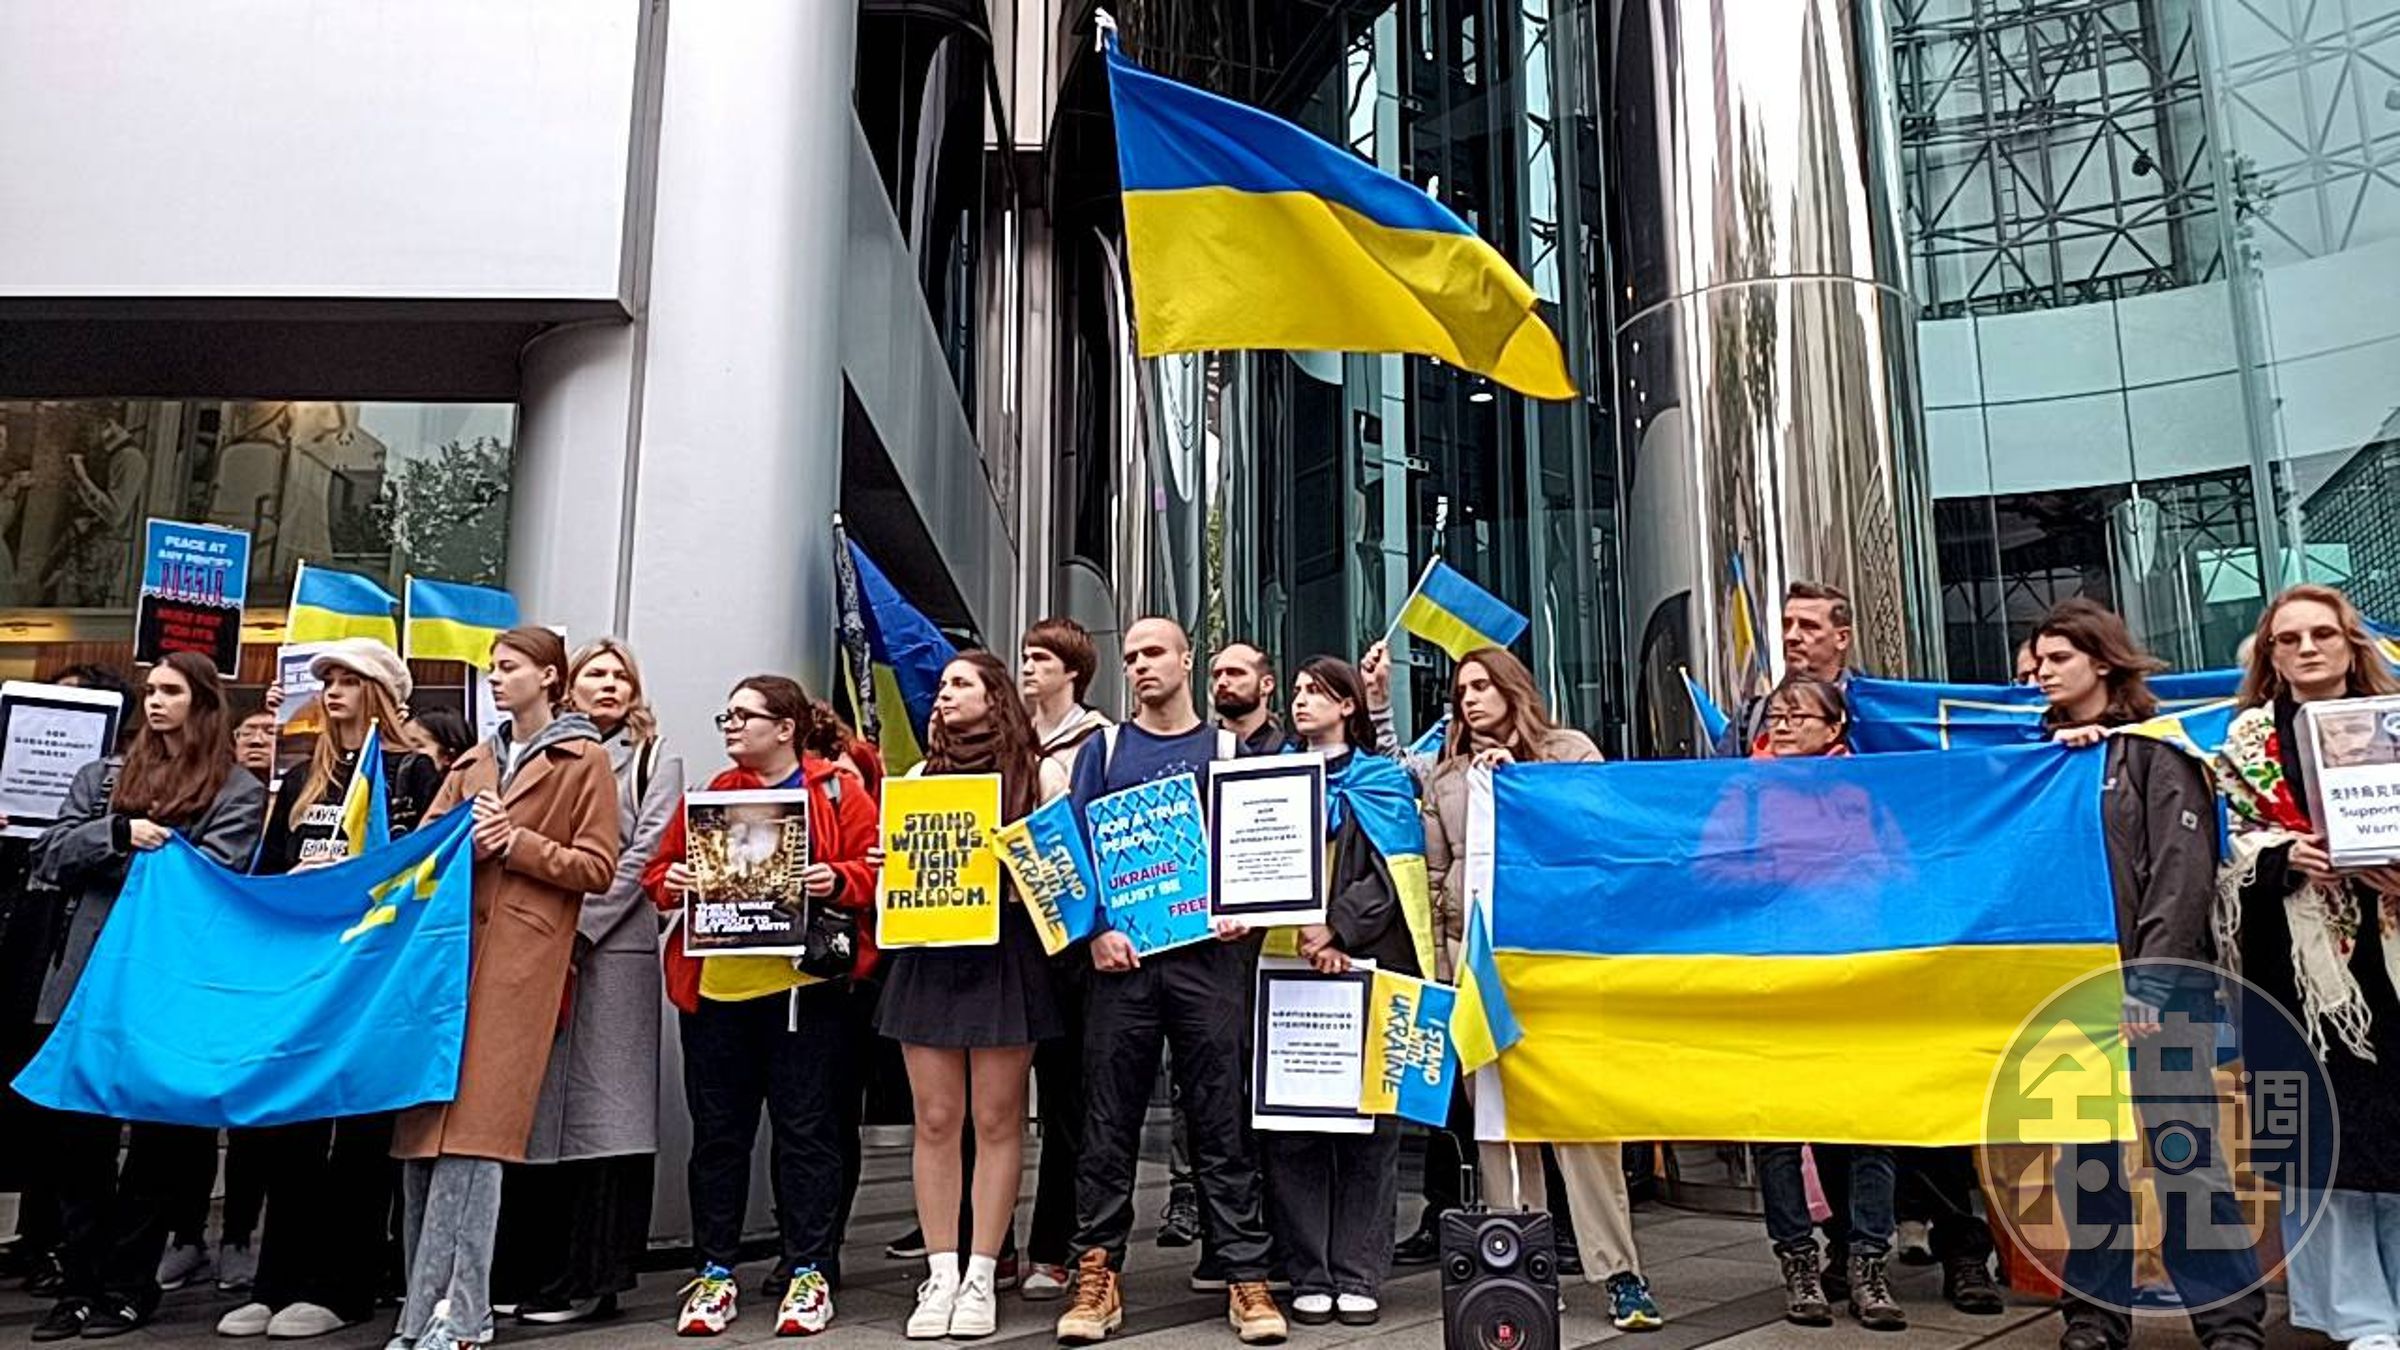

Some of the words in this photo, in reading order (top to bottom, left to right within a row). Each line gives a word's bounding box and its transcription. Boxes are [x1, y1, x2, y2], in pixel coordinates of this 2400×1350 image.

[165, 536, 206, 552] PEACE
[208, 541, 228, 554] AT
[160, 560, 224, 603] RUSSIA
[904, 811, 976, 832] STAND
[1098, 816, 1130, 837] FOR
[1132, 812, 1147, 828] A
[891, 831, 948, 852] WITH
[908, 848, 972, 870] FIGHT
[1051, 844, 1086, 900] STAND
[916, 869, 957, 892] FOR
[1006, 835, 1063, 934] UKRAINE
[1108, 860, 1178, 890] UKRAINE
[886, 886, 991, 910] FREEDOM.
[1111, 883, 1157, 909] MUST
[1158, 877, 1182, 895] BE
[1382, 993, 1412, 1095] UKRAINE
[1422, 1026, 1445, 1087] STAND
